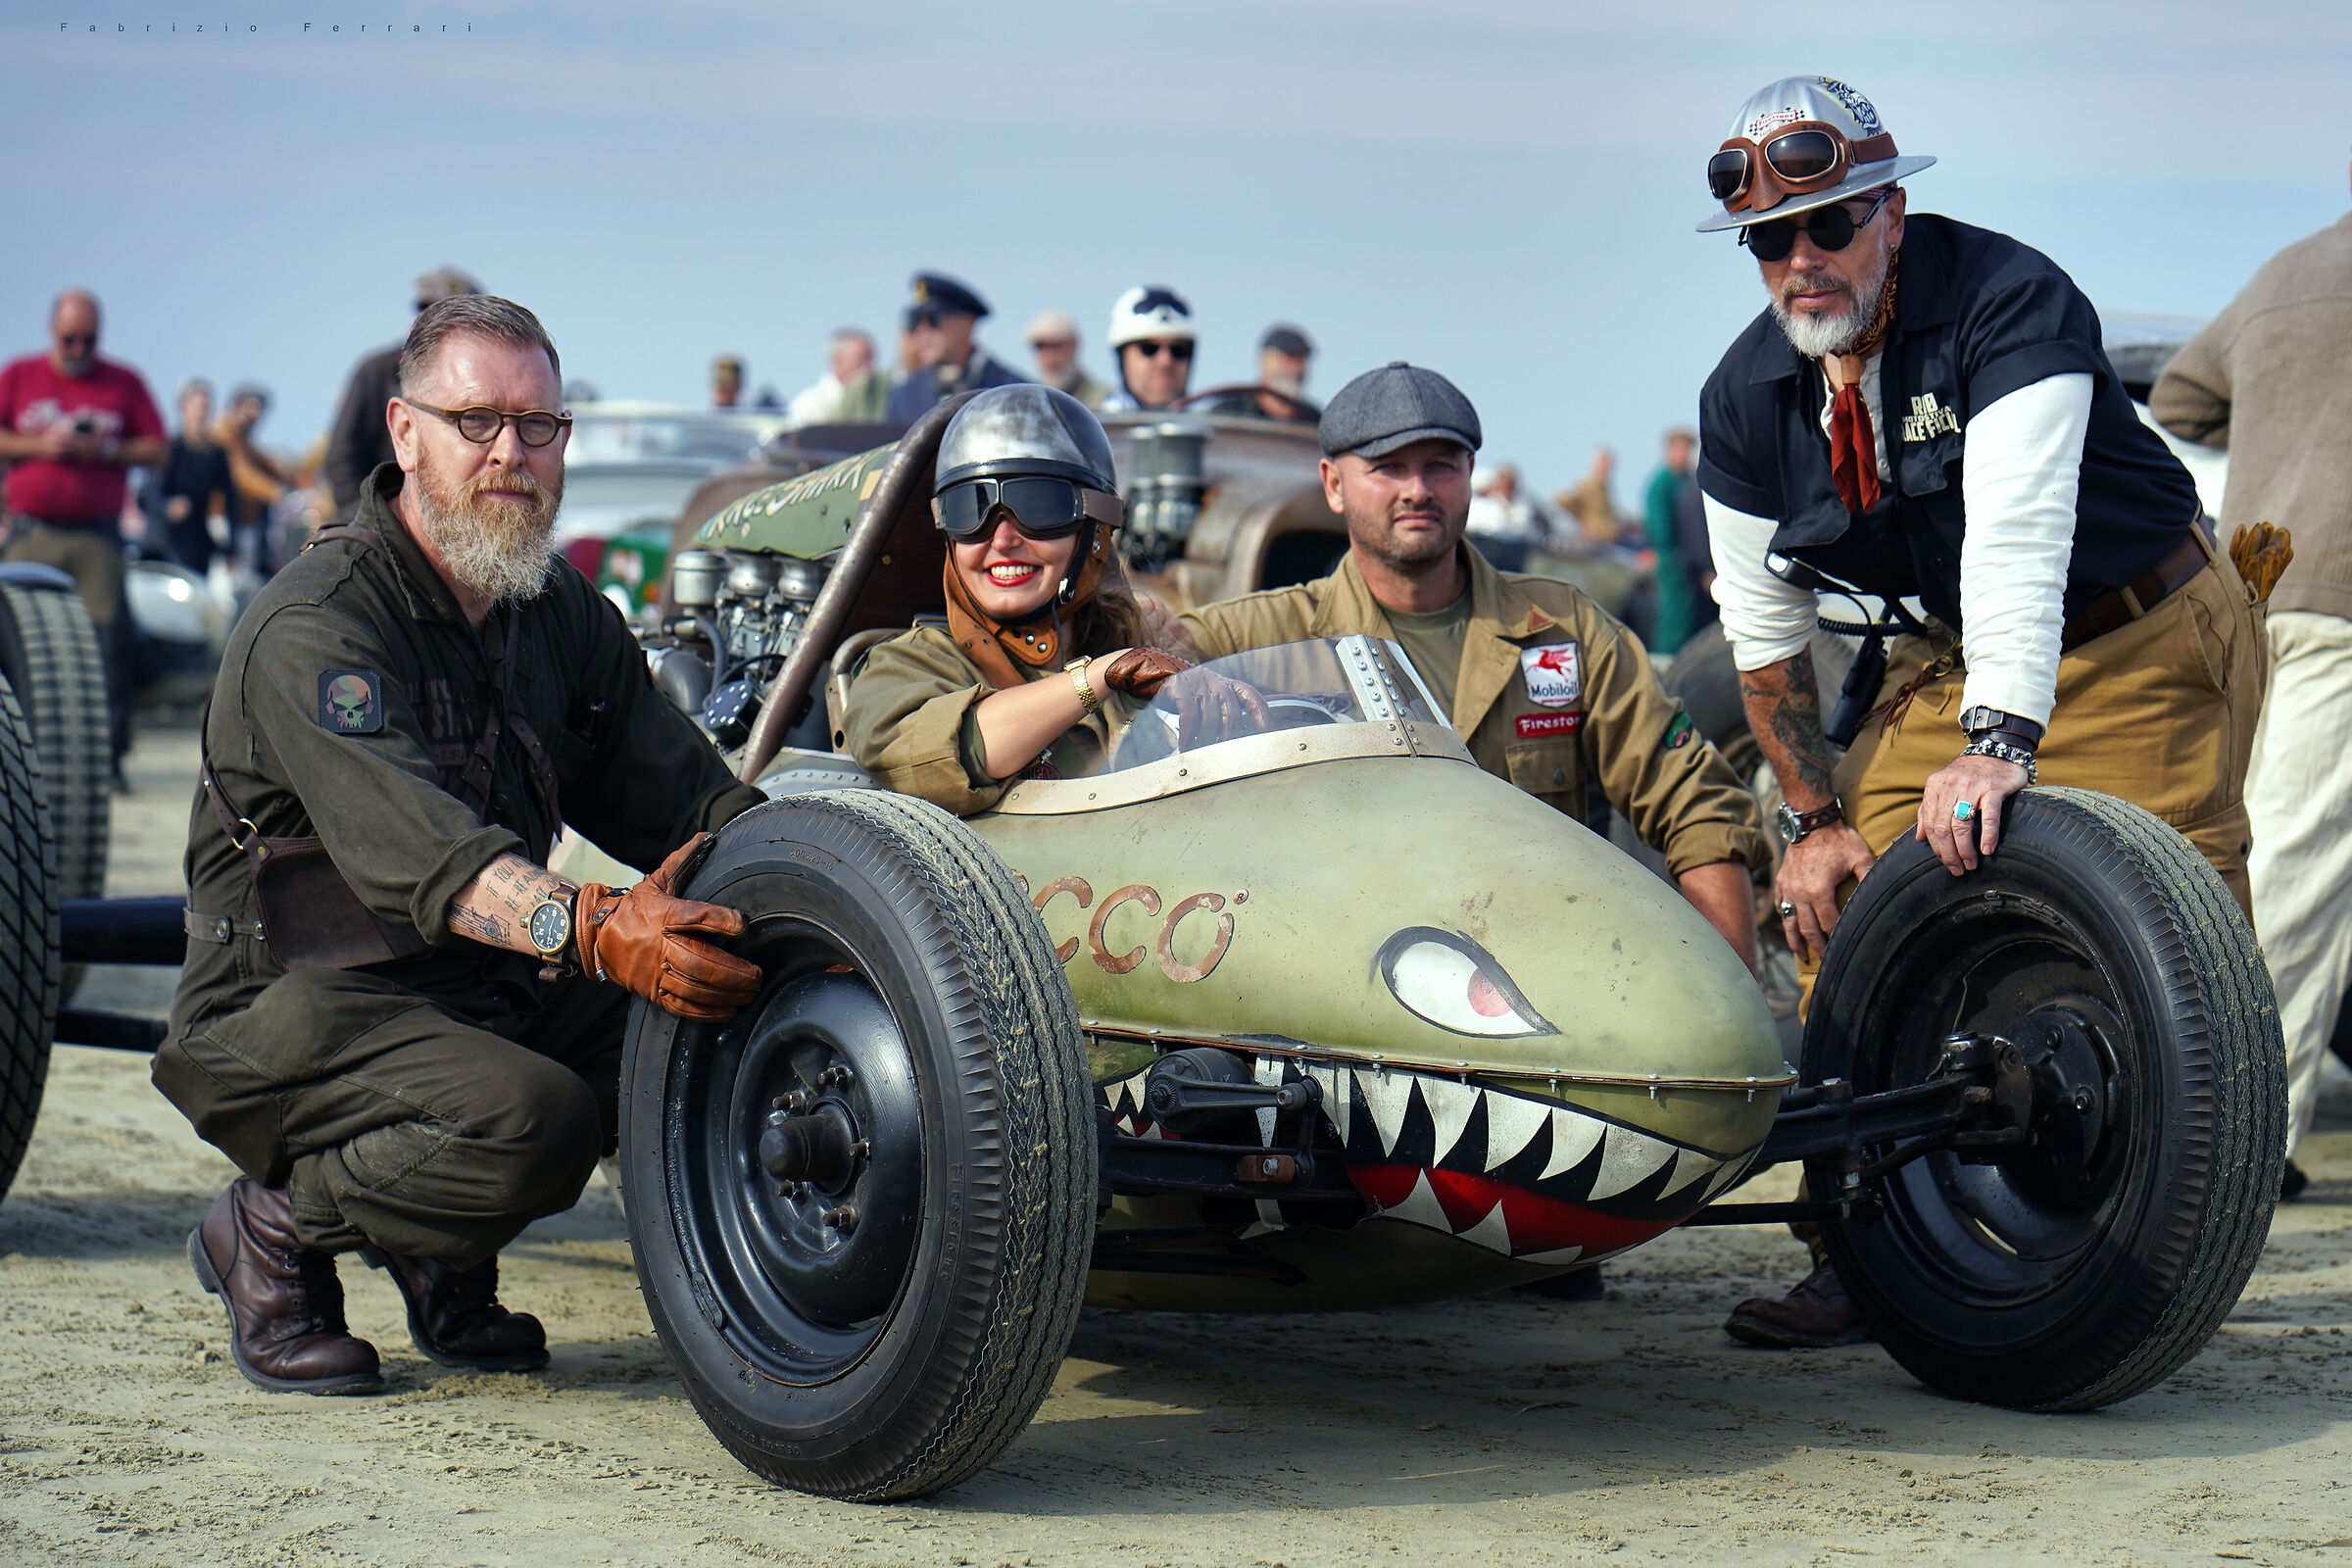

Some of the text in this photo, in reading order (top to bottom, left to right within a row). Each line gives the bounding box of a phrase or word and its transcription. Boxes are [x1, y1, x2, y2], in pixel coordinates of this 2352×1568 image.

[1530, 682, 1578, 698] Mobiloil
[1519, 715, 1581, 734] Firesto
[493, 862, 514, 884] YOU
[1013, 868, 1235, 984] CCO
